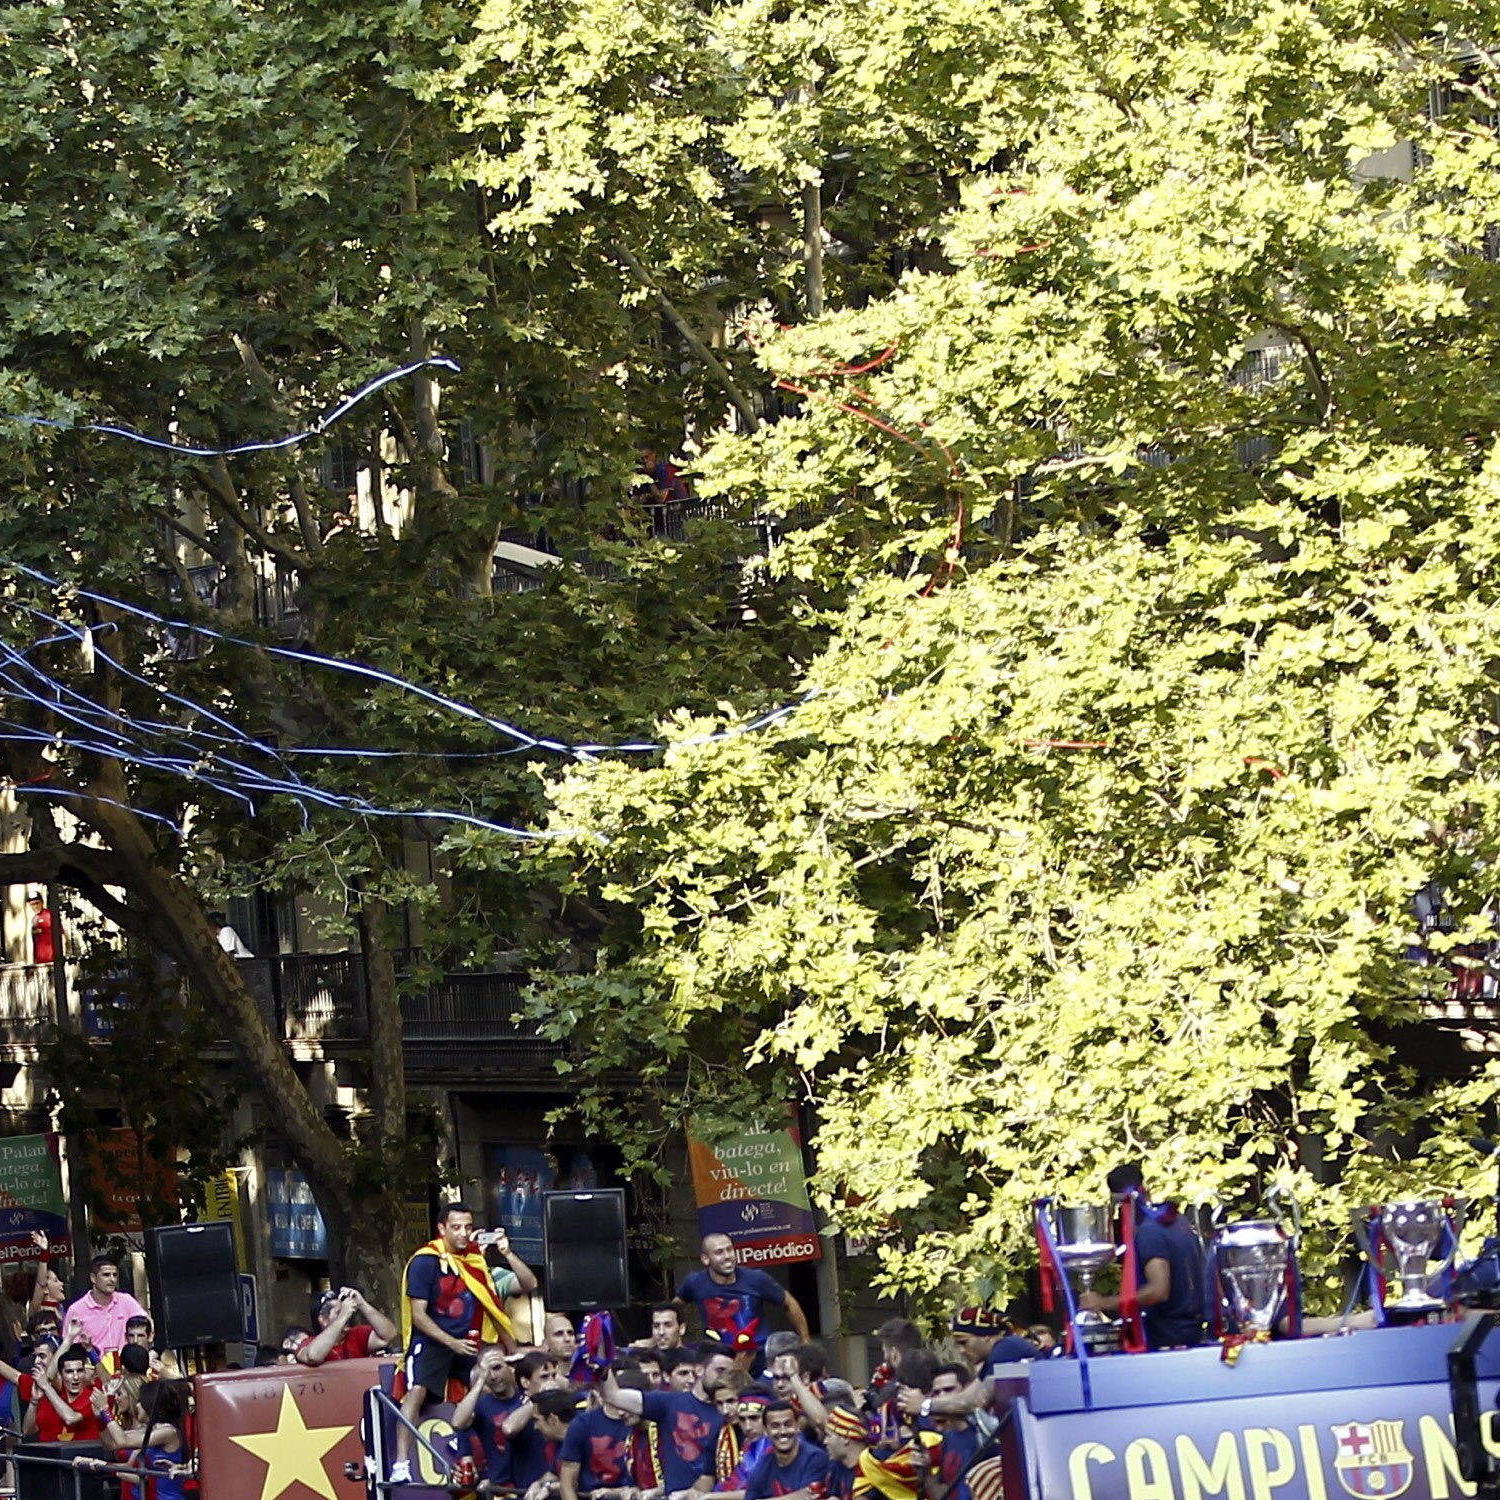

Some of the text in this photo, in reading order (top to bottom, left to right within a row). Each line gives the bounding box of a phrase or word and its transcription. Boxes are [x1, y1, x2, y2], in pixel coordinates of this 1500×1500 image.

[3, 1145, 47, 1160] Palau
[714, 1141, 781, 1161] batega,
[709, 1160, 790, 1181] viu-lo en
[719, 1176, 788, 1200] directe!
[736, 1238, 814, 1265] lPeriódico
